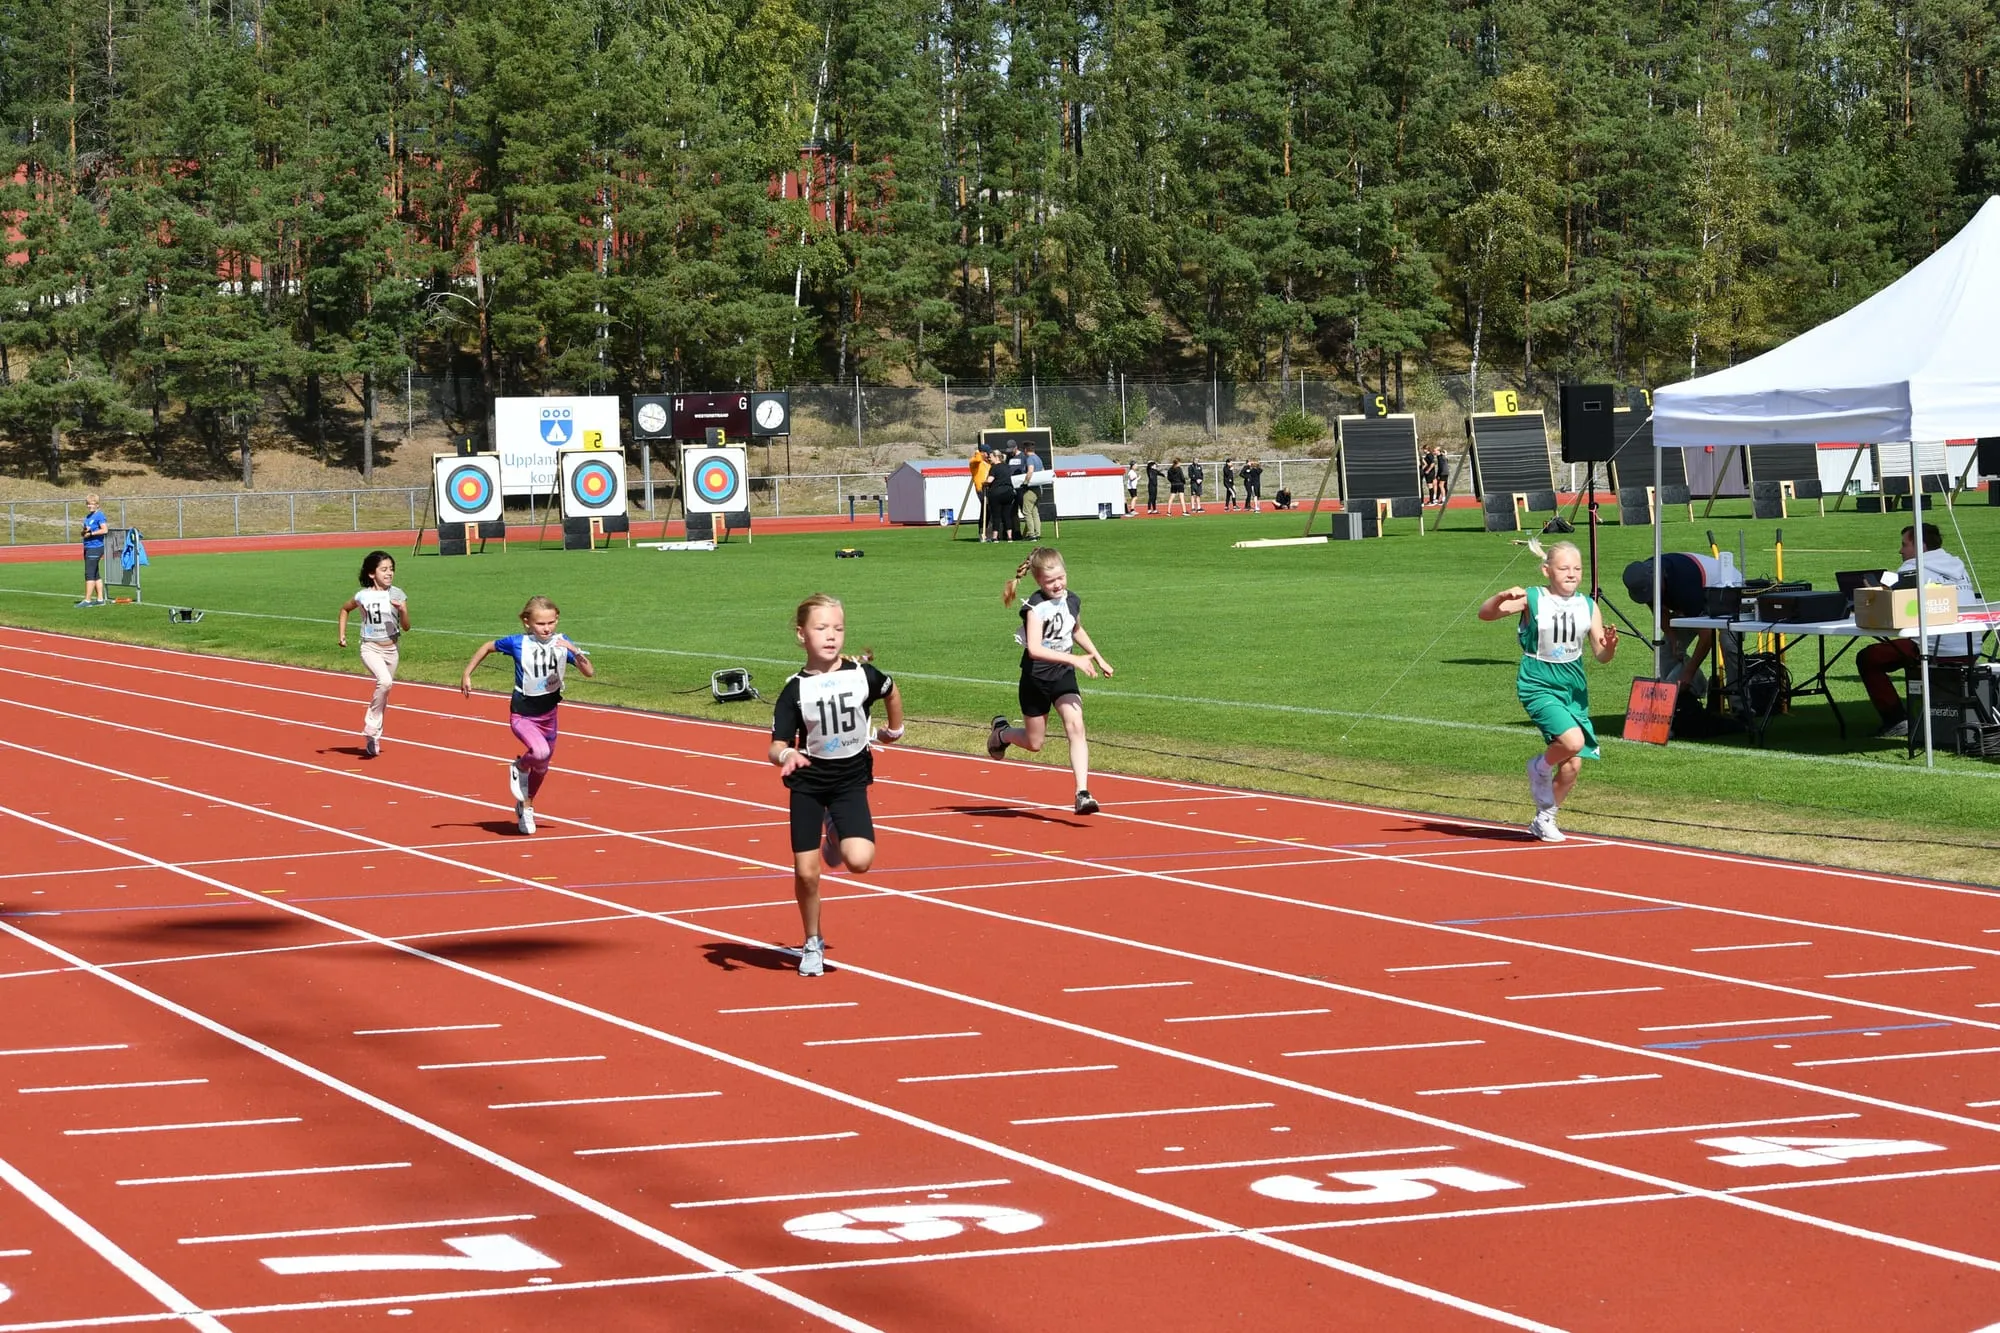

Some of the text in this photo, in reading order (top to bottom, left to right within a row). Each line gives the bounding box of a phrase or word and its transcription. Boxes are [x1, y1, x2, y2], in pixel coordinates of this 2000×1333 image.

[674, 398, 684, 411] H
[738, 397, 748, 410] G
[1375, 396, 1387, 415] 5
[1506, 394, 1516, 412] 6
[1016, 413, 1026, 427] 4
[466, 438, 472, 453] 1
[593, 432, 602, 448] 2
[717, 429, 726, 445] 3
[364, 602, 382, 624] 13
[1552, 611, 1576, 643] 111
[532, 646, 558, 678] 114
[816, 692, 856, 736] 115
[1929, 704, 1959, 718] eneration
[1695, 1136, 1948, 1168] 4
[1250, 1166, 1525, 1204] 5
[782, 1204, 1045, 1244] 6
[260, 1234, 563, 1275] 7
